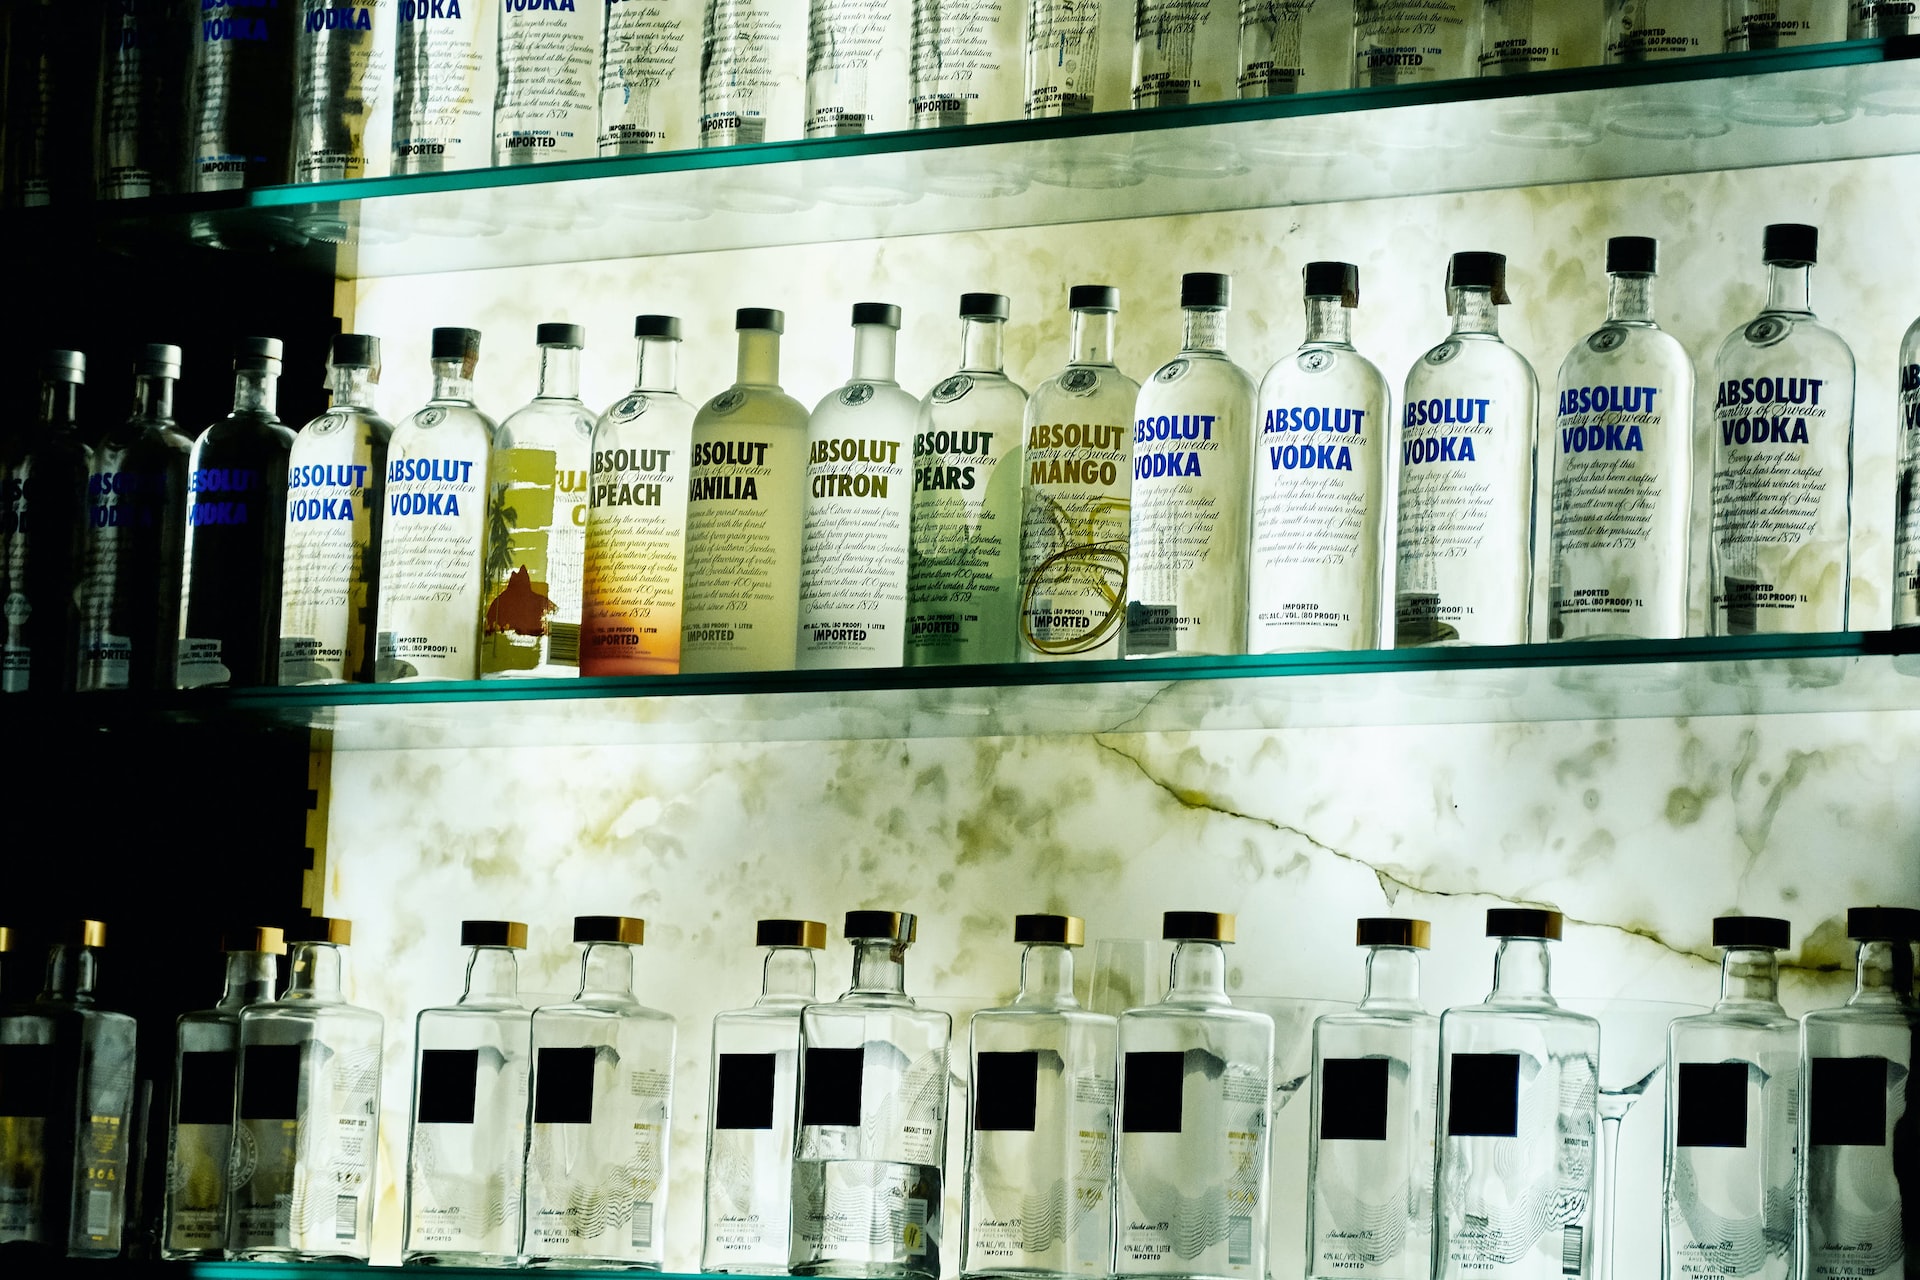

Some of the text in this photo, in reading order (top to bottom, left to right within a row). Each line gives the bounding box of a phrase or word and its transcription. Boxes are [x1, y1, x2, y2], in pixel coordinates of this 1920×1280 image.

[400, 0, 461, 22] VODKA
[1742, 13, 1776, 24] IMPORTED
[1860, 3, 1916, 20] IMPORTED
[306, 8, 372, 33] VODKA
[203, 18, 268, 42] VODKA
[1629, 29, 1665, 38] IMPORTED
[1494, 39, 1527, 48] IMPORTED
[1247, 61, 1274, 71] IMPORTED
[1367, 54, 1423, 68] IMPORTED
[1142, 72, 1170, 82] IMPORTED
[1032, 86, 1058, 96] IMPORTED
[816, 106, 844, 115] IMPORTED
[915, 100, 960, 114] IMPORTED
[609, 123, 636, 131] IMPORTED
[399, 144, 444, 156] IMPORTED
[505, 137, 556, 148] IMPORTED
[202, 162, 248, 173] IMPORTED
[1717, 377, 1823, 408] ABSOLUT
[1558, 386, 1657, 417] ABSOLUT
[1756, 401, 1774, 419] of
[1772, 401, 1827, 418] Sweden
[1264, 407, 1365, 435] ABSOLUT
[1593, 412, 1661, 427] of Sweden
[1133, 415, 1215, 444] ABSOLUT
[1441, 422, 1493, 435] Sweden
[1722, 416, 1809, 446] VODKA
[1029, 424, 1124, 450] ABSOLUT
[1168, 435, 1219, 451] Sweden
[1302, 430, 1318, 446] of
[1318, 429, 1368, 446] Sweden
[1562, 425, 1644, 454] VODKA
[809, 439, 901, 466] ABSOLUT
[913, 431, 993, 459] ABSOLUT
[1403, 437, 1475, 466] VODKA
[948, 451, 997, 466] Sweden
[1064, 447, 1077, 464] of
[1078, 448, 1127, 462] Sweden
[1270, 445, 1352, 472] VODKA
[1728, 449, 1800, 464] Every drop this
[388, 458, 473, 483] ABSOLUT
[724, 464, 771, 476] Sweden
[841, 460, 853, 475] of
[854, 461, 903, 476] Sweden
[1030, 460, 1117, 486] MANGO
[1134, 452, 1201, 480] VODKA
[1752, 465, 1823, 480] has been crafted
[288, 464, 367, 488] ABSOLUT
[627, 470, 674, 483] Sweden
[915, 467, 975, 492] PEARS
[429, 482, 477, 494] Sweden
[690, 477, 757, 501] VANILIA
[812, 474, 888, 499] CITRON
[1772, 480, 1826, 492] winter wheat
[589, 484, 661, 509] APEACH
[290, 498, 354, 522] VODKA
[391, 493, 460, 516] VODKA
[1769, 506, 1817, 516] determined
[189, 502, 248, 526] VODKA
[862, 507, 899, 519] made from
[880, 518, 899, 529] vodka
[1760, 519, 1806, 531] the pursuit
[865, 534, 888, 543] grown
[1756, 532, 1800, 543] since 1879
[1573, 589, 1609, 597] IMPORTED
[1736, 584, 1774, 592] IMPORTED
[1605, 598, 1643, 607] PROOF) 1L
[1769, 593, 1797, 602] PROOF)
[1034, 616, 1090, 628] IMPORTED
[1301, 612, 1313, 620] (80
[1314, 612, 1340, 621] PROOF)
[813, 629, 866, 641] IMPORTED
[911, 621, 960, 635] IMPORTED
[687, 630, 734, 642] IMPORTED
